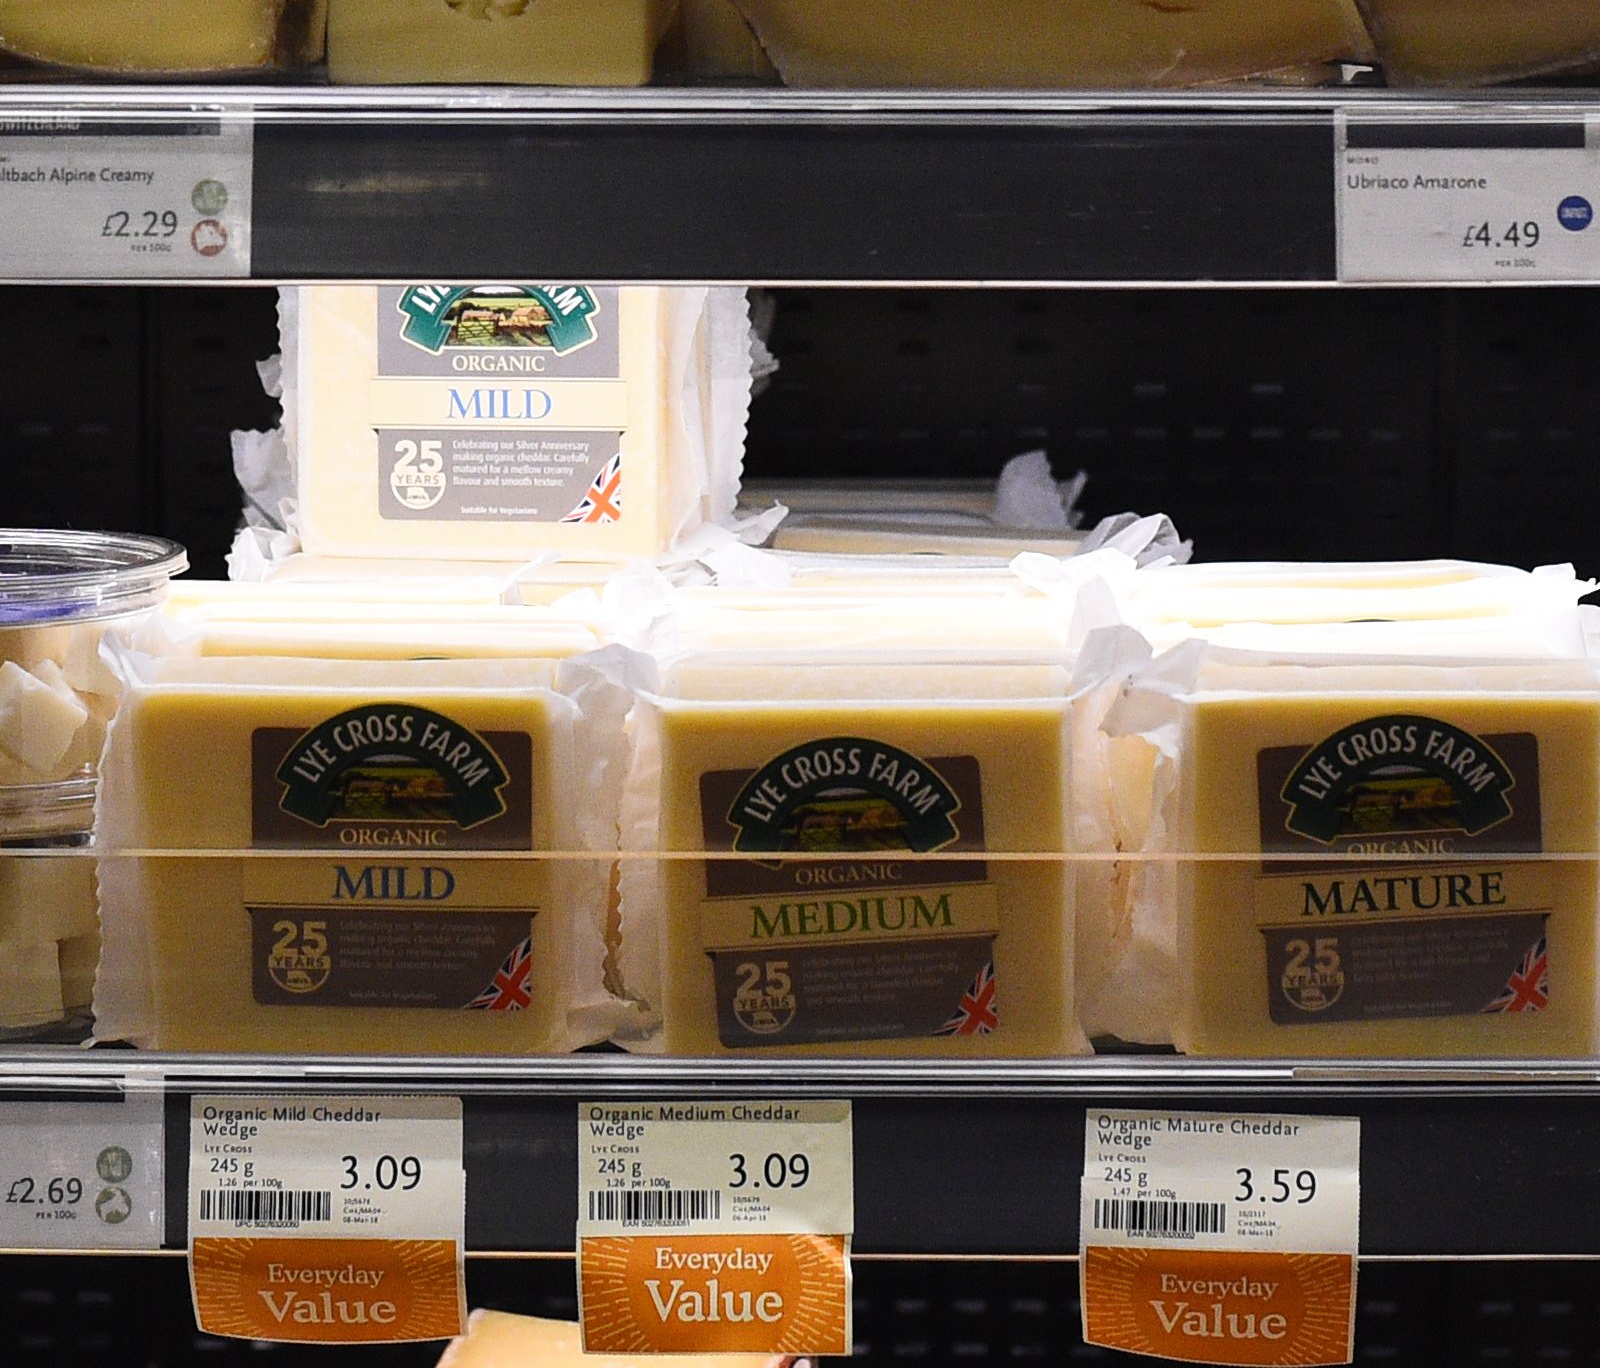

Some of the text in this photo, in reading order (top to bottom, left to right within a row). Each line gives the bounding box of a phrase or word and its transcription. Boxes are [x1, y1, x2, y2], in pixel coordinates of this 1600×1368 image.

[49, 168, 96, 185] Alpine
[100, 168, 154, 185] Creamy
[1347, 175, 1487, 189] Ubriaco Amarone
[102, 210, 178, 238] £2.29
[1463, 221, 1540, 248] £4.49
[451, 354, 546, 374] ORGANIC
[446, 388, 553, 421] MILD
[452, 440, 499, 452] Celebrating
[516, 440, 539, 450] Silver
[452, 452, 484, 463] making
[485, 453, 515, 464] organic
[396, 473, 441, 487] YEARS
[292, 714, 491, 788] LYE CROSS FARM
[339, 828, 448, 847] ORGANIC
[331, 865, 456, 901] MILD
[1300, 871, 1507, 917] MATURE
[750, 893, 956, 939] MEDIUM
[203, 1106, 381, 1124] Organic Mild Cheddar
[589, 1105, 801, 1124] Organic Medium Cheddar
[1097, 1115, 1300, 1136] Organic Mature Cheddar
[203, 1122, 259, 1140] Wedge
[589, 1122, 646, 1140] Wedge
[1097, 1132, 1153, 1151] Wedge
[210, 1158, 254, 1178] 245 g
[340, 1155, 422, 1191] 3.09
[728, 1153, 810, 1189] 3.09
[5, 1177, 83, 1205] £2.69
[1234, 1167, 1317, 1205] 3.59
[655, 1246, 774, 1275] Everyday
[267, 1263, 386, 1289] Everyday
[1161, 1273, 1279, 1301] Everyday
[258, 1290, 398, 1325] Value
[644, 1278, 784, 1323] Value
[1149, 1300, 1288, 1340] Value
